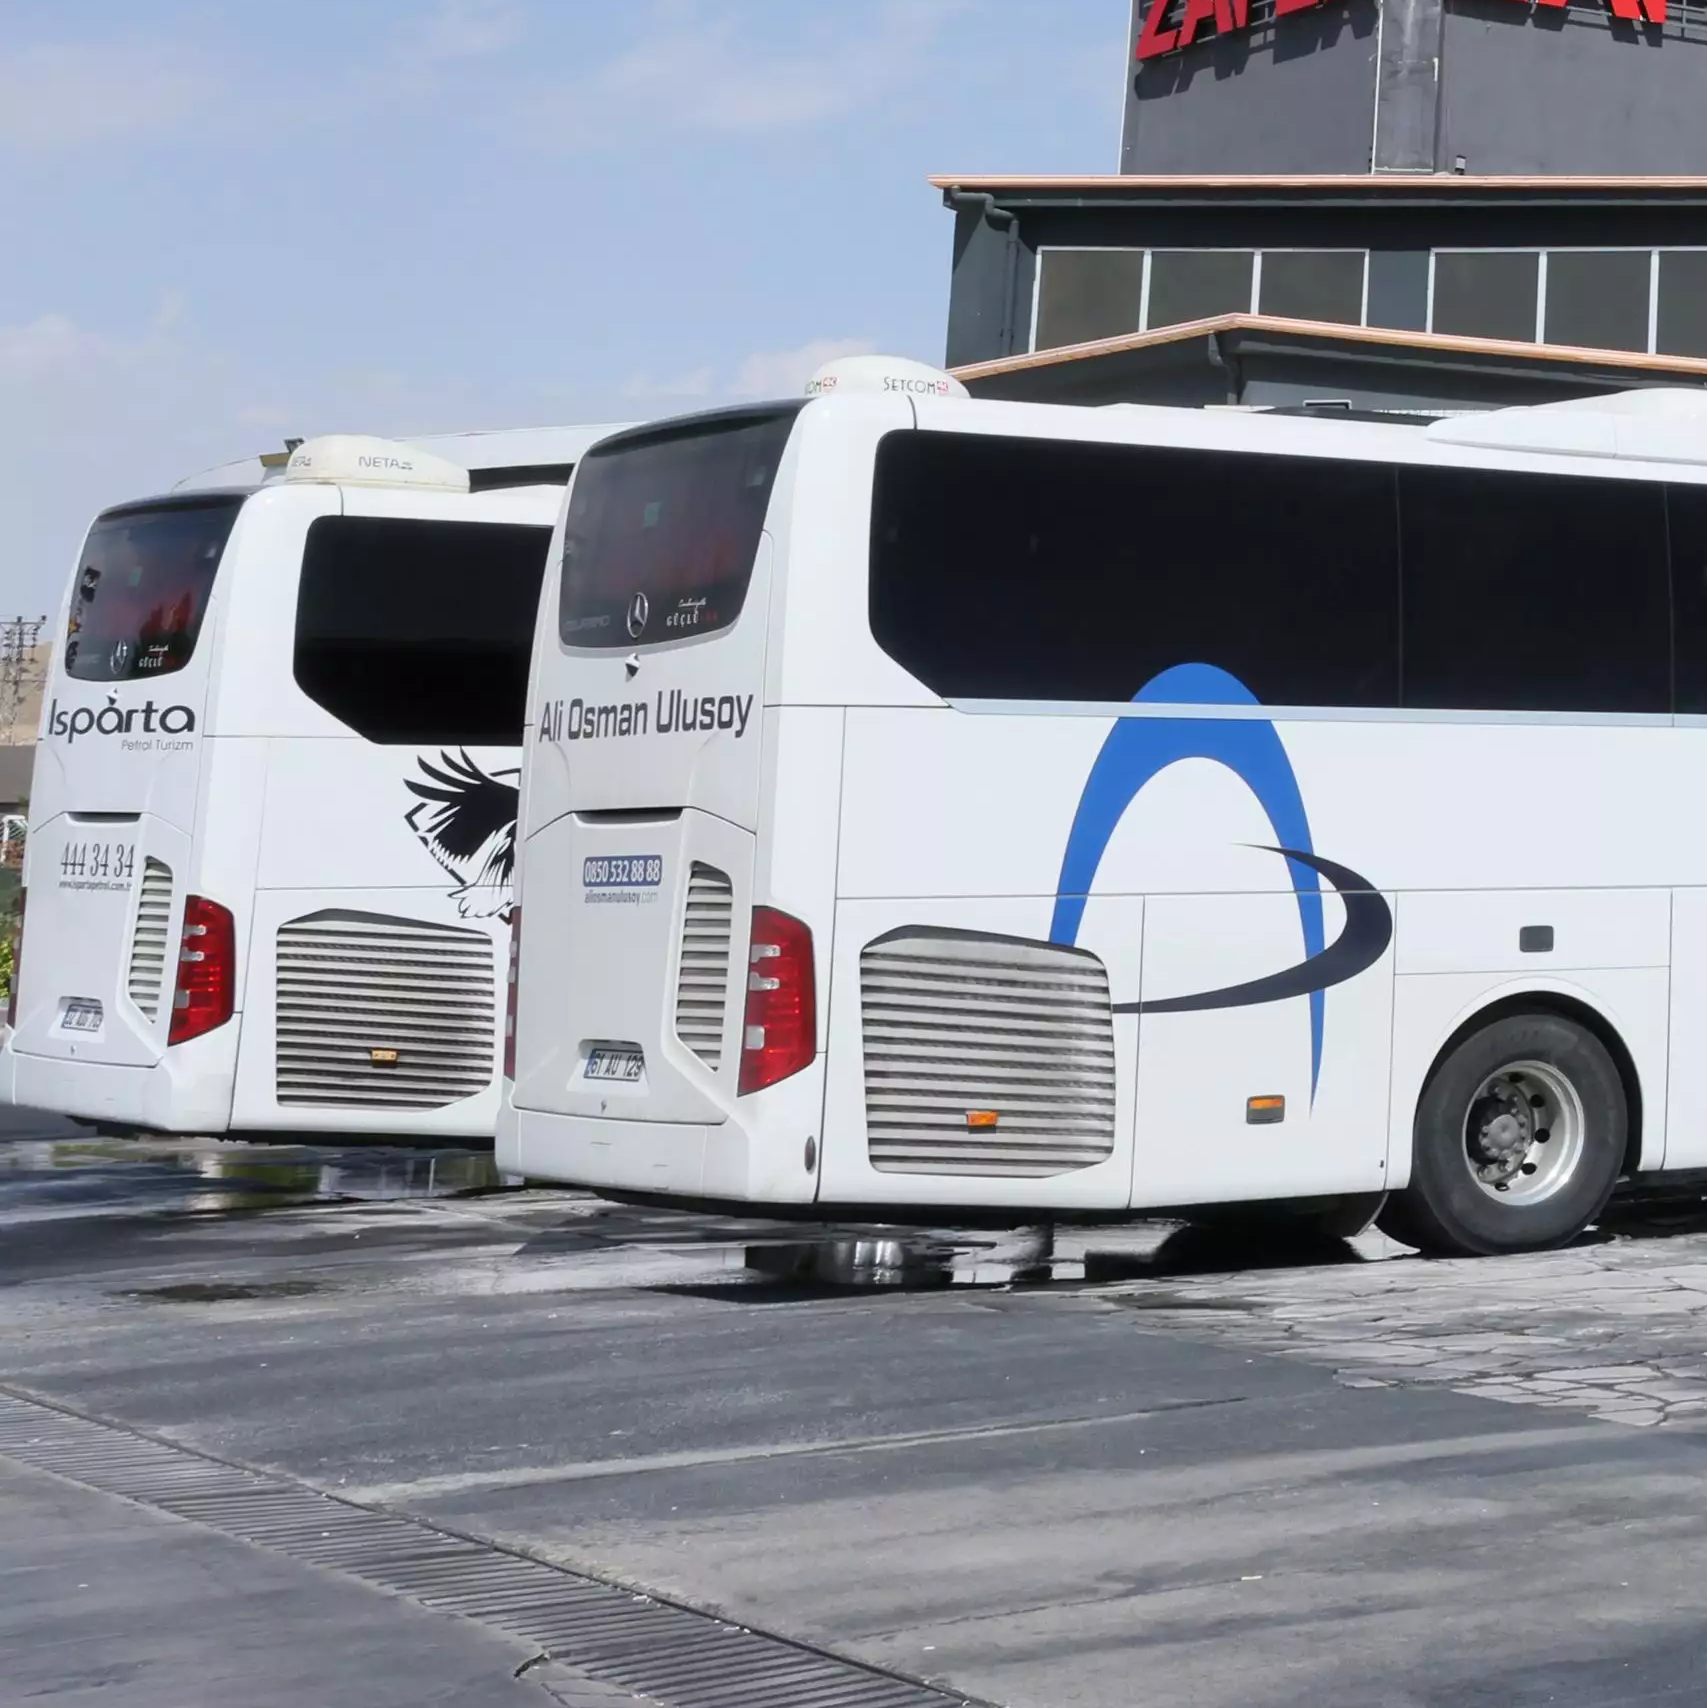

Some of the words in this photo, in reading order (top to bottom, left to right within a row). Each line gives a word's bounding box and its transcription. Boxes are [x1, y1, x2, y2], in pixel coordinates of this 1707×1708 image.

[48, 698, 196, 744] Isparta
[539, 700, 564, 743] Ali
[567, 698, 649, 741] Osman
[655, 689, 754, 739] Ulusoy
[60, 842, 87, 877] 444
[90, 842, 110, 877] 34
[113, 843, 135, 878] 34
[585, 860, 609, 883] 0850
[609, 859, 630, 883] 532
[630, 859, 645, 883] 88
[645, 859, 661, 882] 88
